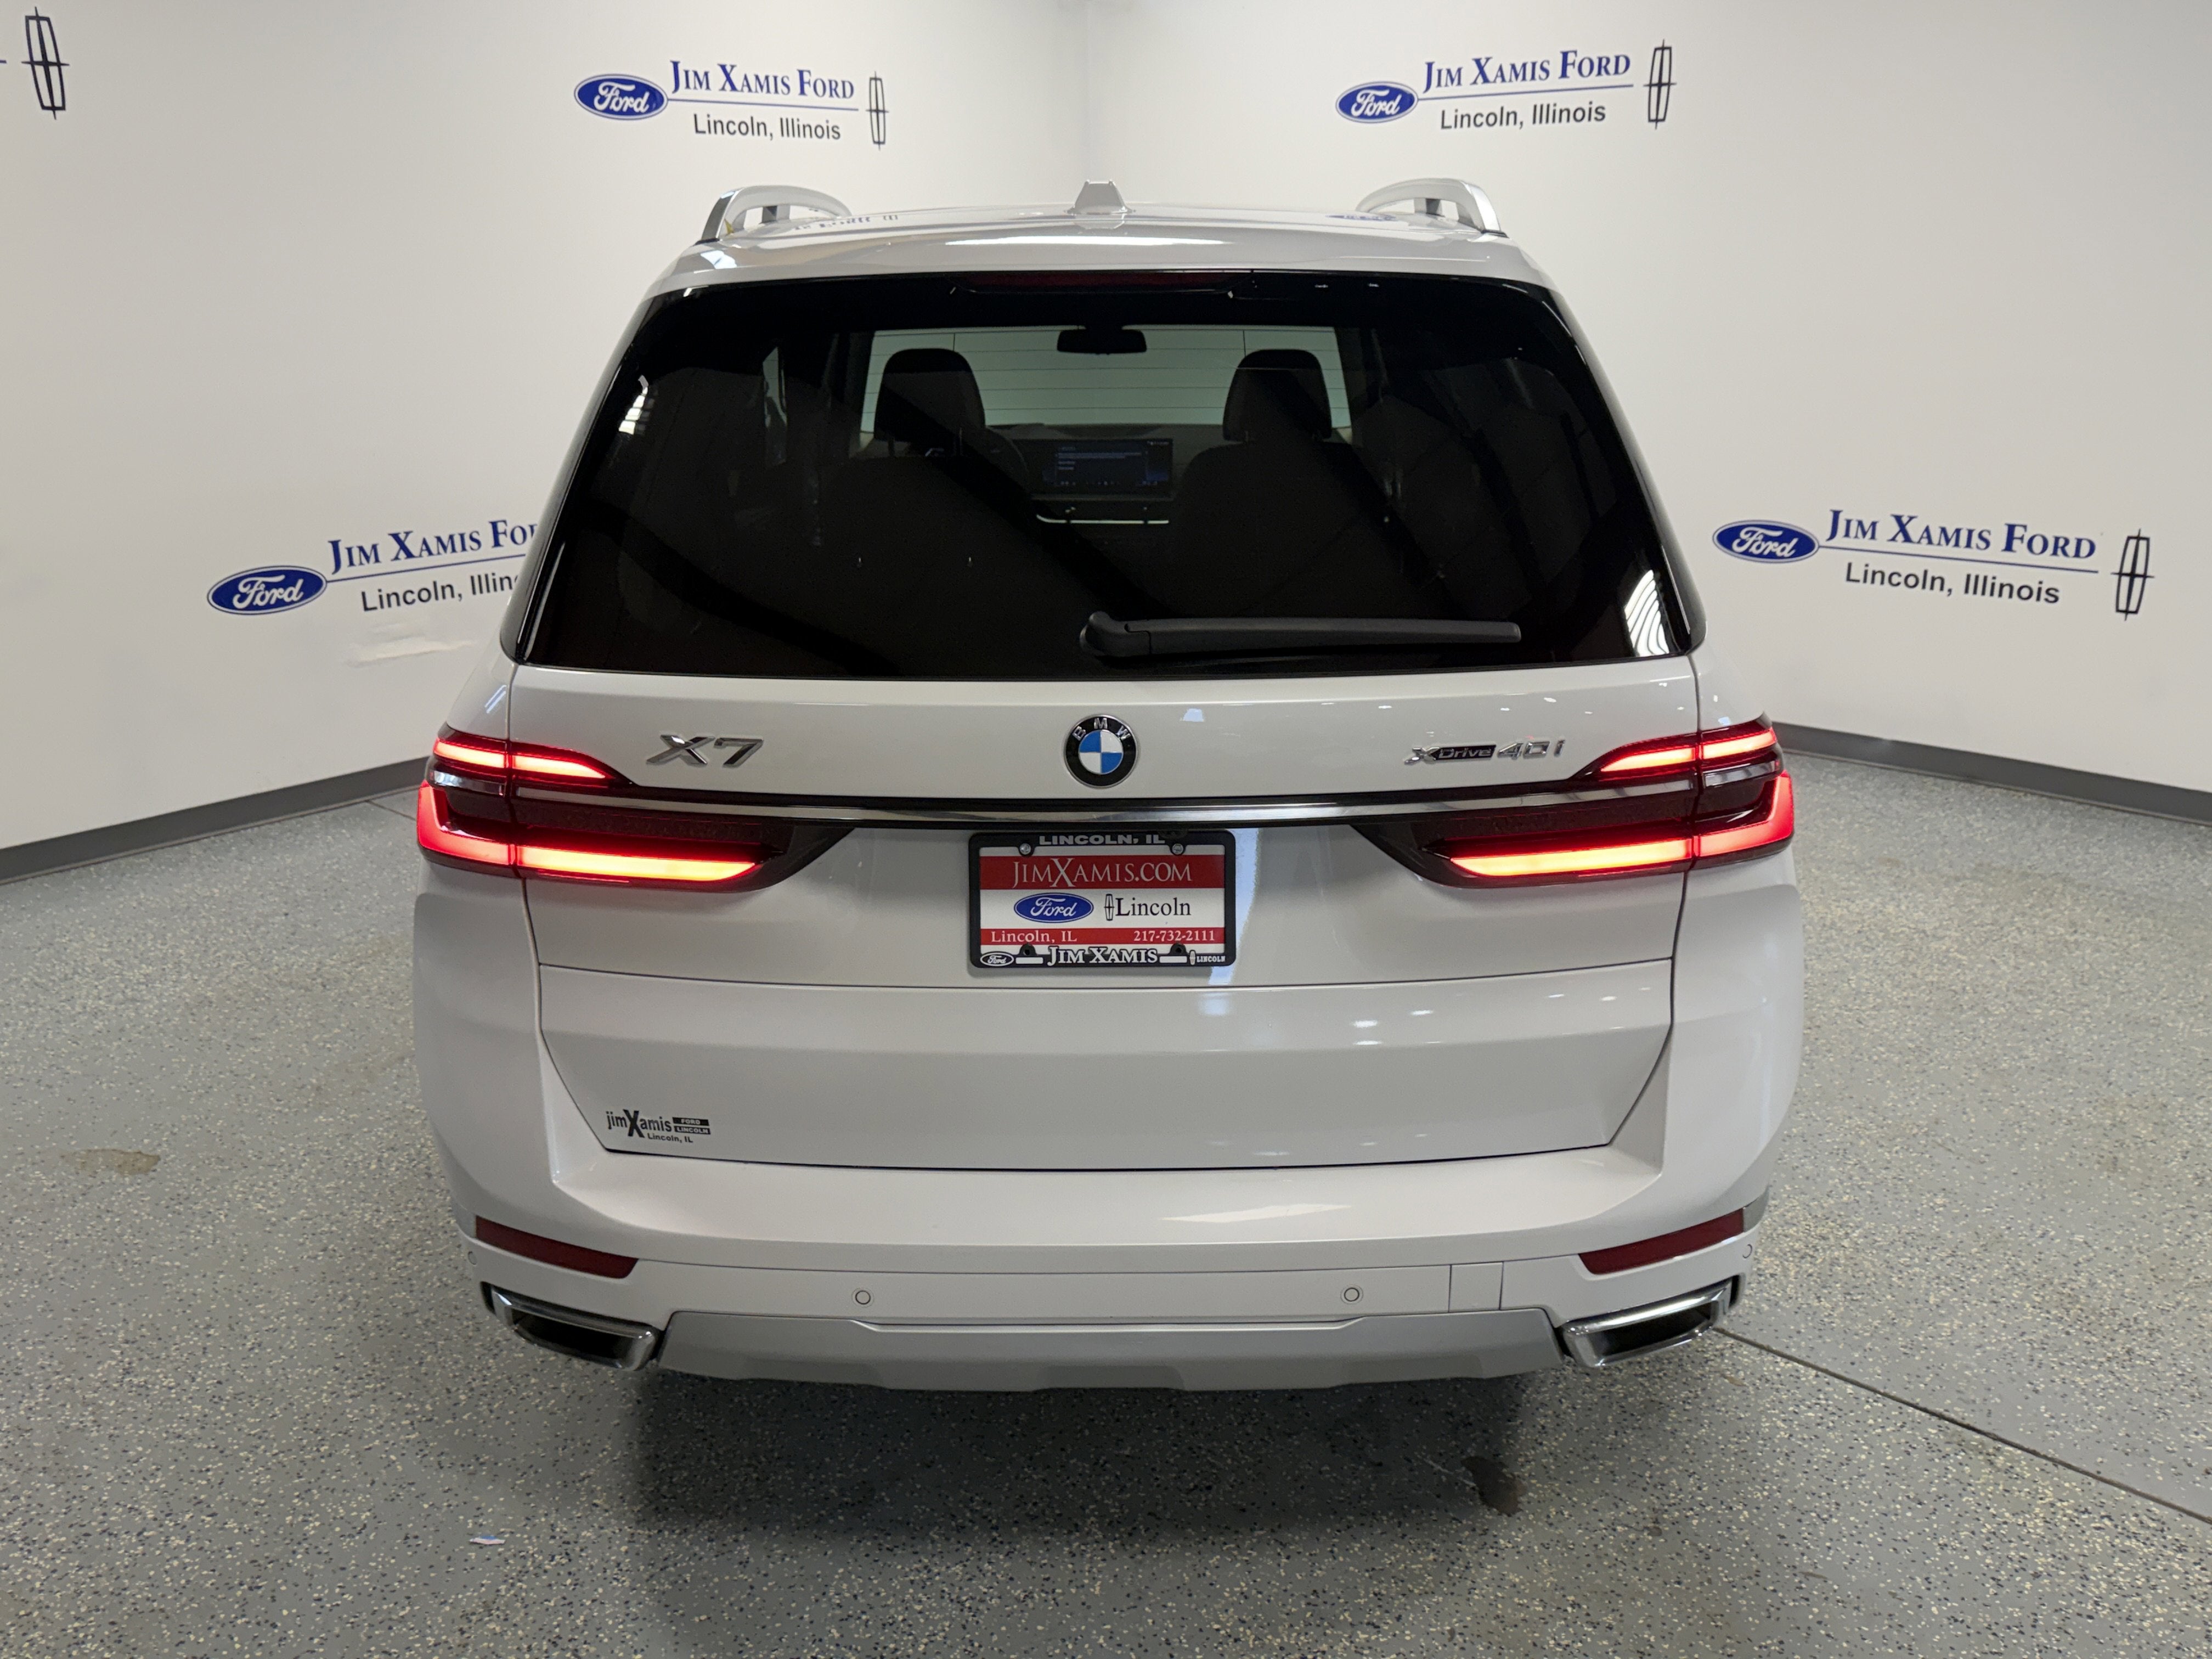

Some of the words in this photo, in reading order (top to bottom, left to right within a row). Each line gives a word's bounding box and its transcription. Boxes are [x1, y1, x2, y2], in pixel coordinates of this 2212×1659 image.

[670, 60, 711, 94] JIM
[718, 64, 791, 95] XAMIS
[797, 69, 854, 99] FORD
[1423, 61, 1463, 93] JIM
[1470, 57, 1550, 85] XAMIS
[1558, 50, 1630, 79] FORD
[594, 81, 650, 113] Ford
[1351, 89, 1401, 116] Ford
[693, 114, 774, 140] Lincoln,
[780, 117, 840, 140] Illinois
[1441, 106, 1523, 129] Lincoln,
[1532, 101, 1606, 125] Illinois
[328, 539, 382, 574] JIM
[388, 529, 482, 562] XAMIS
[488, 520, 537, 548] FO
[1732, 527, 1797, 558] Ford
[1826, 509, 1880, 540] JIM
[1887, 514, 1991, 550] XAMIS
[2001, 523, 2097, 558] FORD
[233, 574, 303, 609] Ford
[362, 580, 462, 612] Lincoln,
[470, 572, 518, 596] Illin
[1846, 562, 1953, 596] Lincoln,
[1964, 574, 2060, 604] Illinois
[1073, 718, 1131, 741] BMW
[646, 735, 763, 768] X7
[1039, 836, 1139, 845] LINCOLN,
[1146, 835, 1165, 844] IL
[1012, 858, 1192, 887] JIMXAMIS.COM
[1030, 897, 1076, 917] Ford
[1115, 898, 1192, 916] Lincoln
[991, 931, 1055, 944] Lincoln,
[1062, 931, 1077, 942] IL
[1134, 930, 1215, 941] 217-732-2111
[988, 955, 1006, 964] Ford
[1047, 946, 1085, 966] JIM
[1090, 947, 1158, 964] XAMIS
[647, 1133, 682, 1143] Lincoln,
